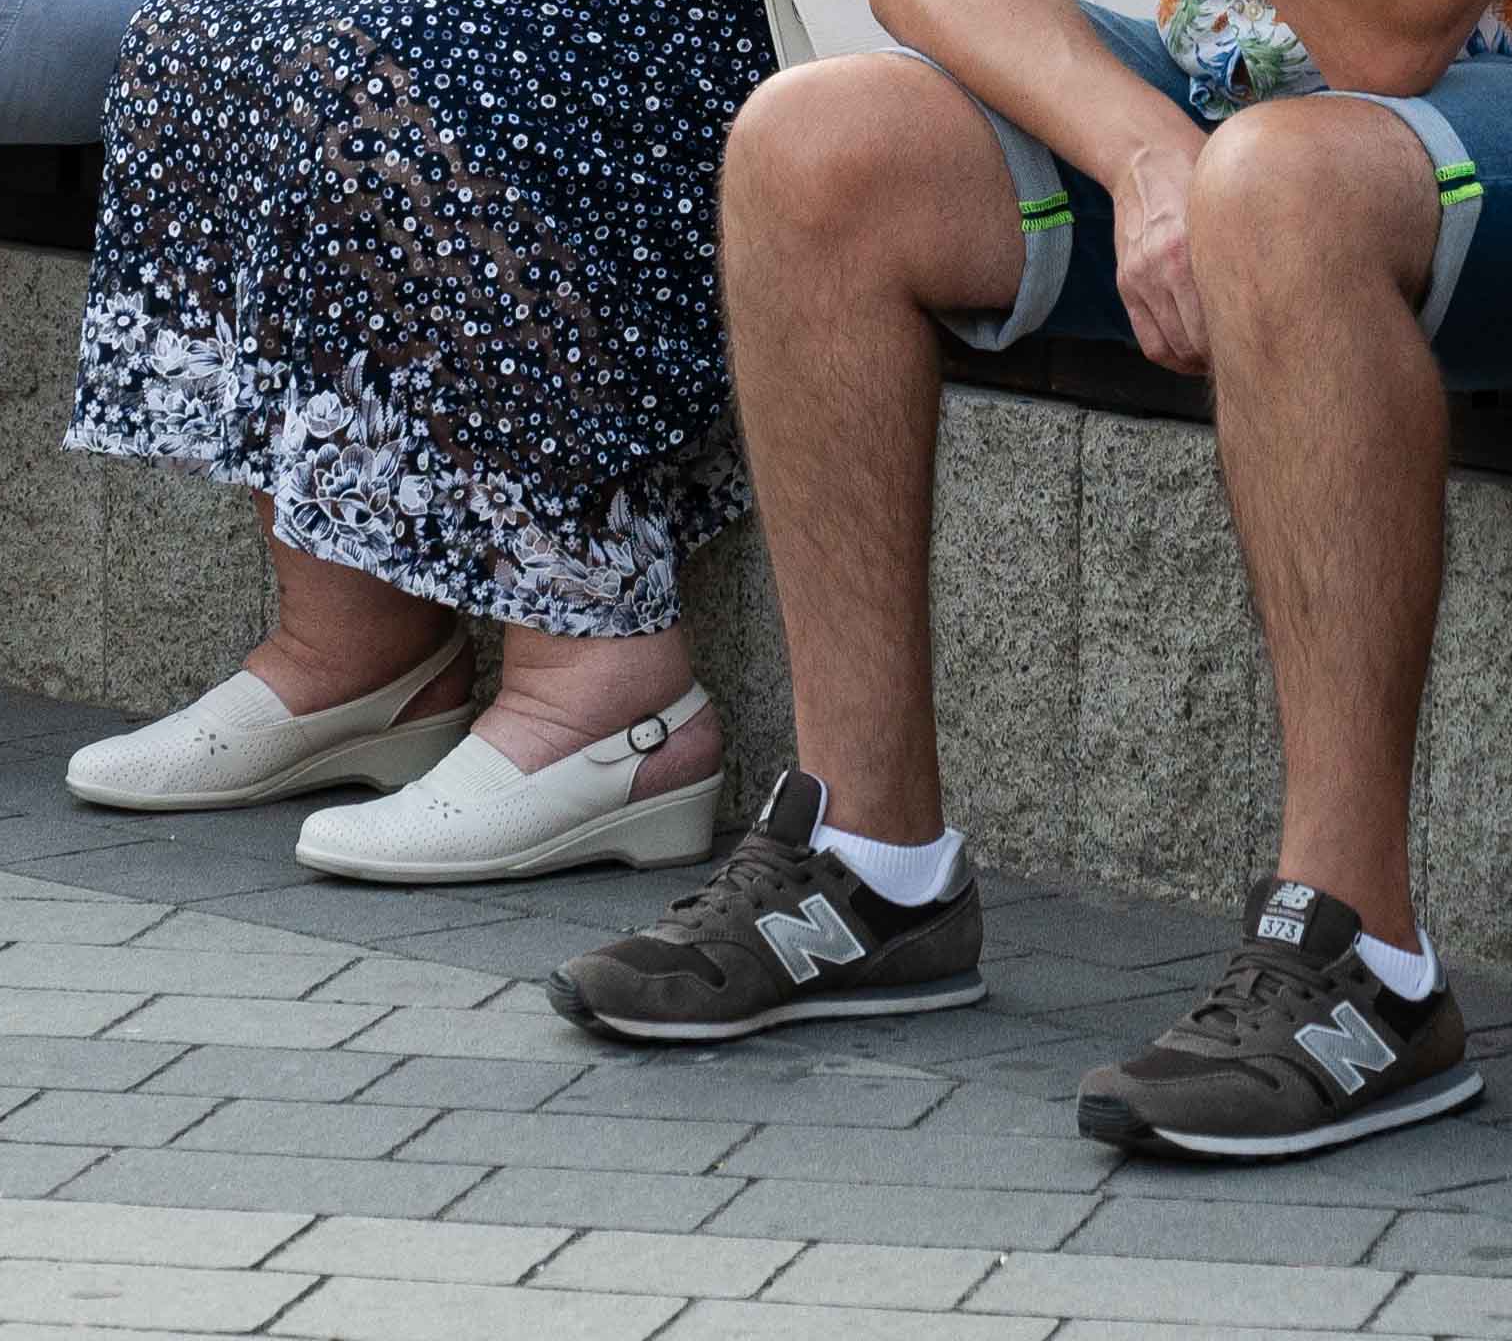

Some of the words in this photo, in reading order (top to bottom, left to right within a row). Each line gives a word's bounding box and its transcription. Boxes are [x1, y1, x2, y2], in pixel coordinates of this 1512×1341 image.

[754, 892, 866, 985] N
[1263, 918, 1298, 942] 373
[1294, 999, 1397, 1096] N
